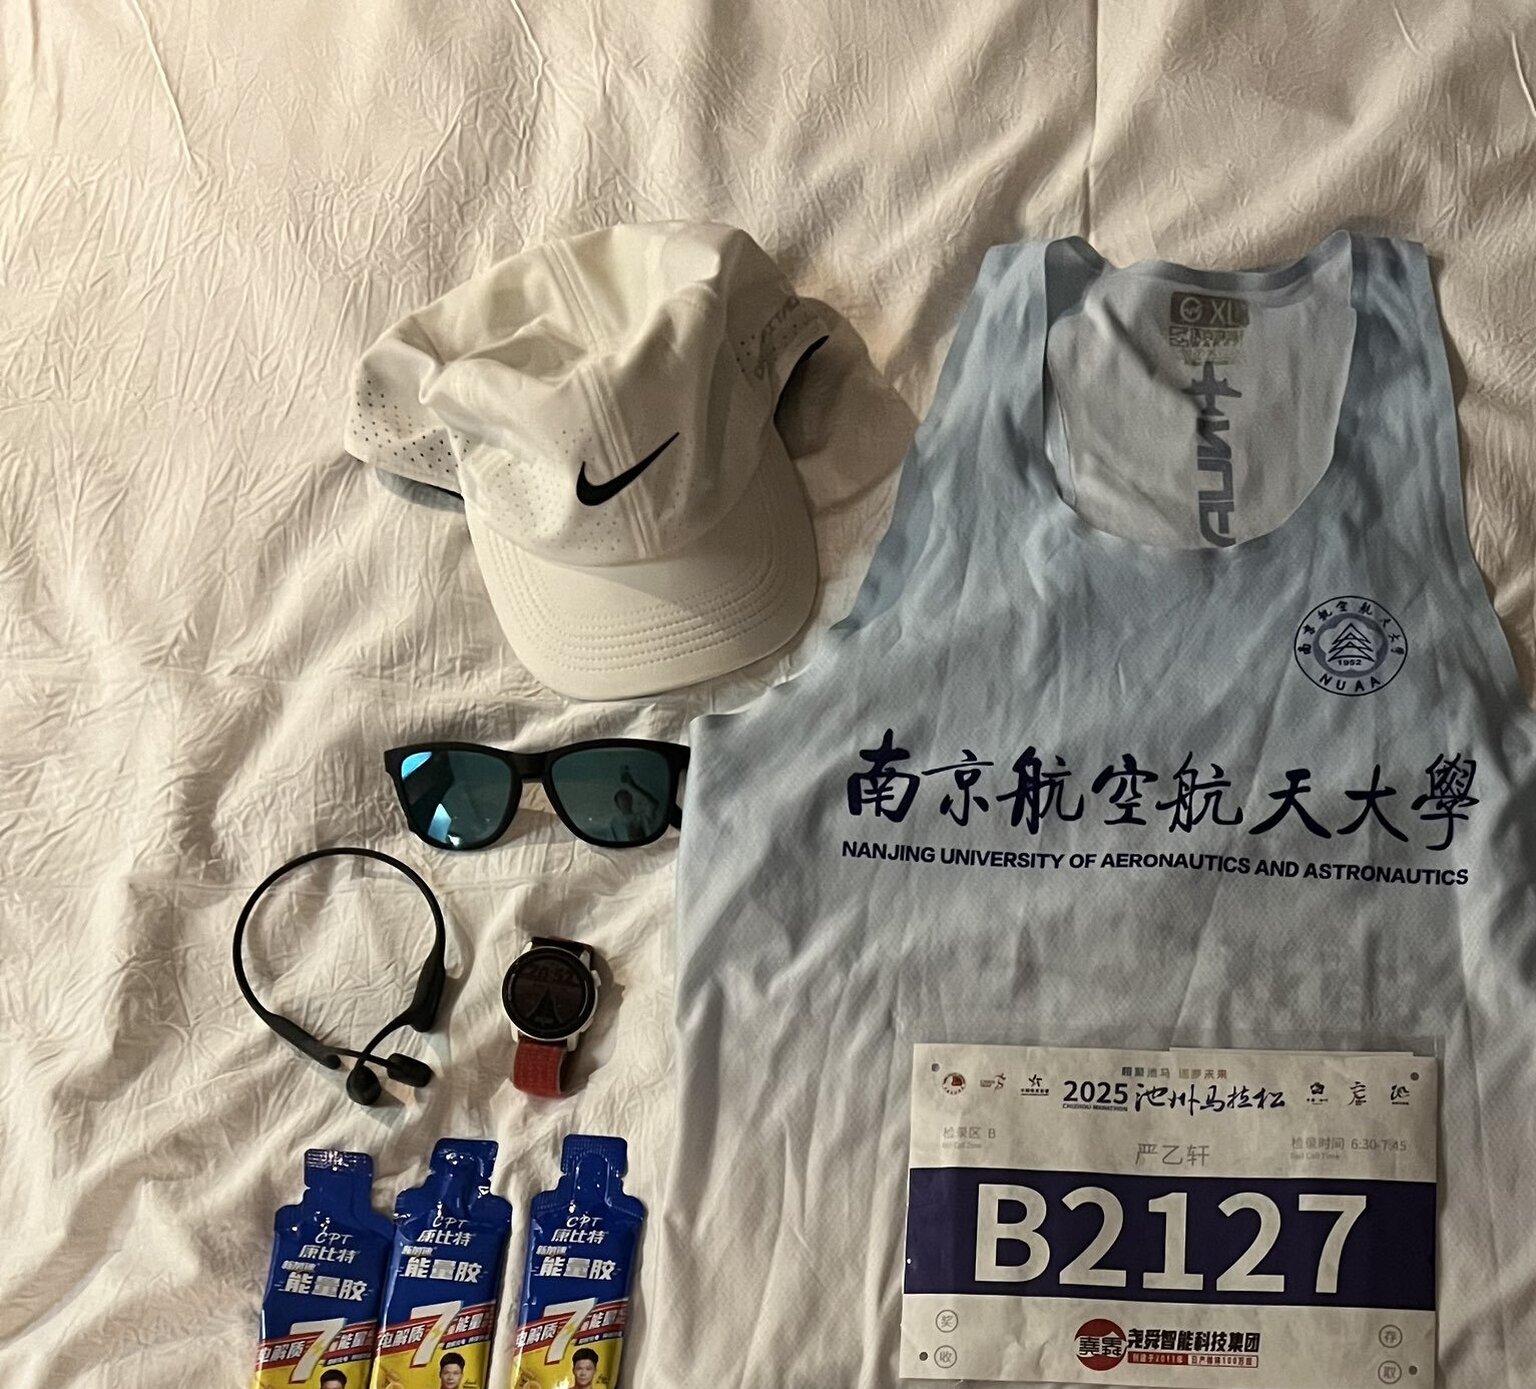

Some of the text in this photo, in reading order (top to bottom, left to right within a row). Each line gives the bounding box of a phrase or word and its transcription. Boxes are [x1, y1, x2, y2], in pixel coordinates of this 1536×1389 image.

[1320, 673, 1380, 692] NUAA
[842, 840, 1469, 887] NANJING UNIVERSITY OF AERONAUTICS AND ASTRONAUTICS
[1063, 1080, 1285, 1116] 2025 池州马拉松
[988, 1128, 996, 1139] B
[1291, 1136, 1345, 1152] 检录时间
[1135, 1142, 1210, 1167] 严乙轩
[432, 1215, 469, 1229] CPT
[566, 1214, 602, 1228] CPT
[315, 1232, 353, 1244] CPT
[974, 1183, 1367, 1294] B2127
[405, 1257, 482, 1283] 能量胶
[540, 1257, 616, 1280] 能量胶
[285, 1271, 367, 1301] 能量胶
[409, 1300, 464, 1368] 7
[544, 1297, 597, 1365] 7
[1128, 1328, 1260, 1353] 尧舜智能科技集团
[1383, 1330, 1398, 1344] 存
[288, 1318, 348, 1384] 7
